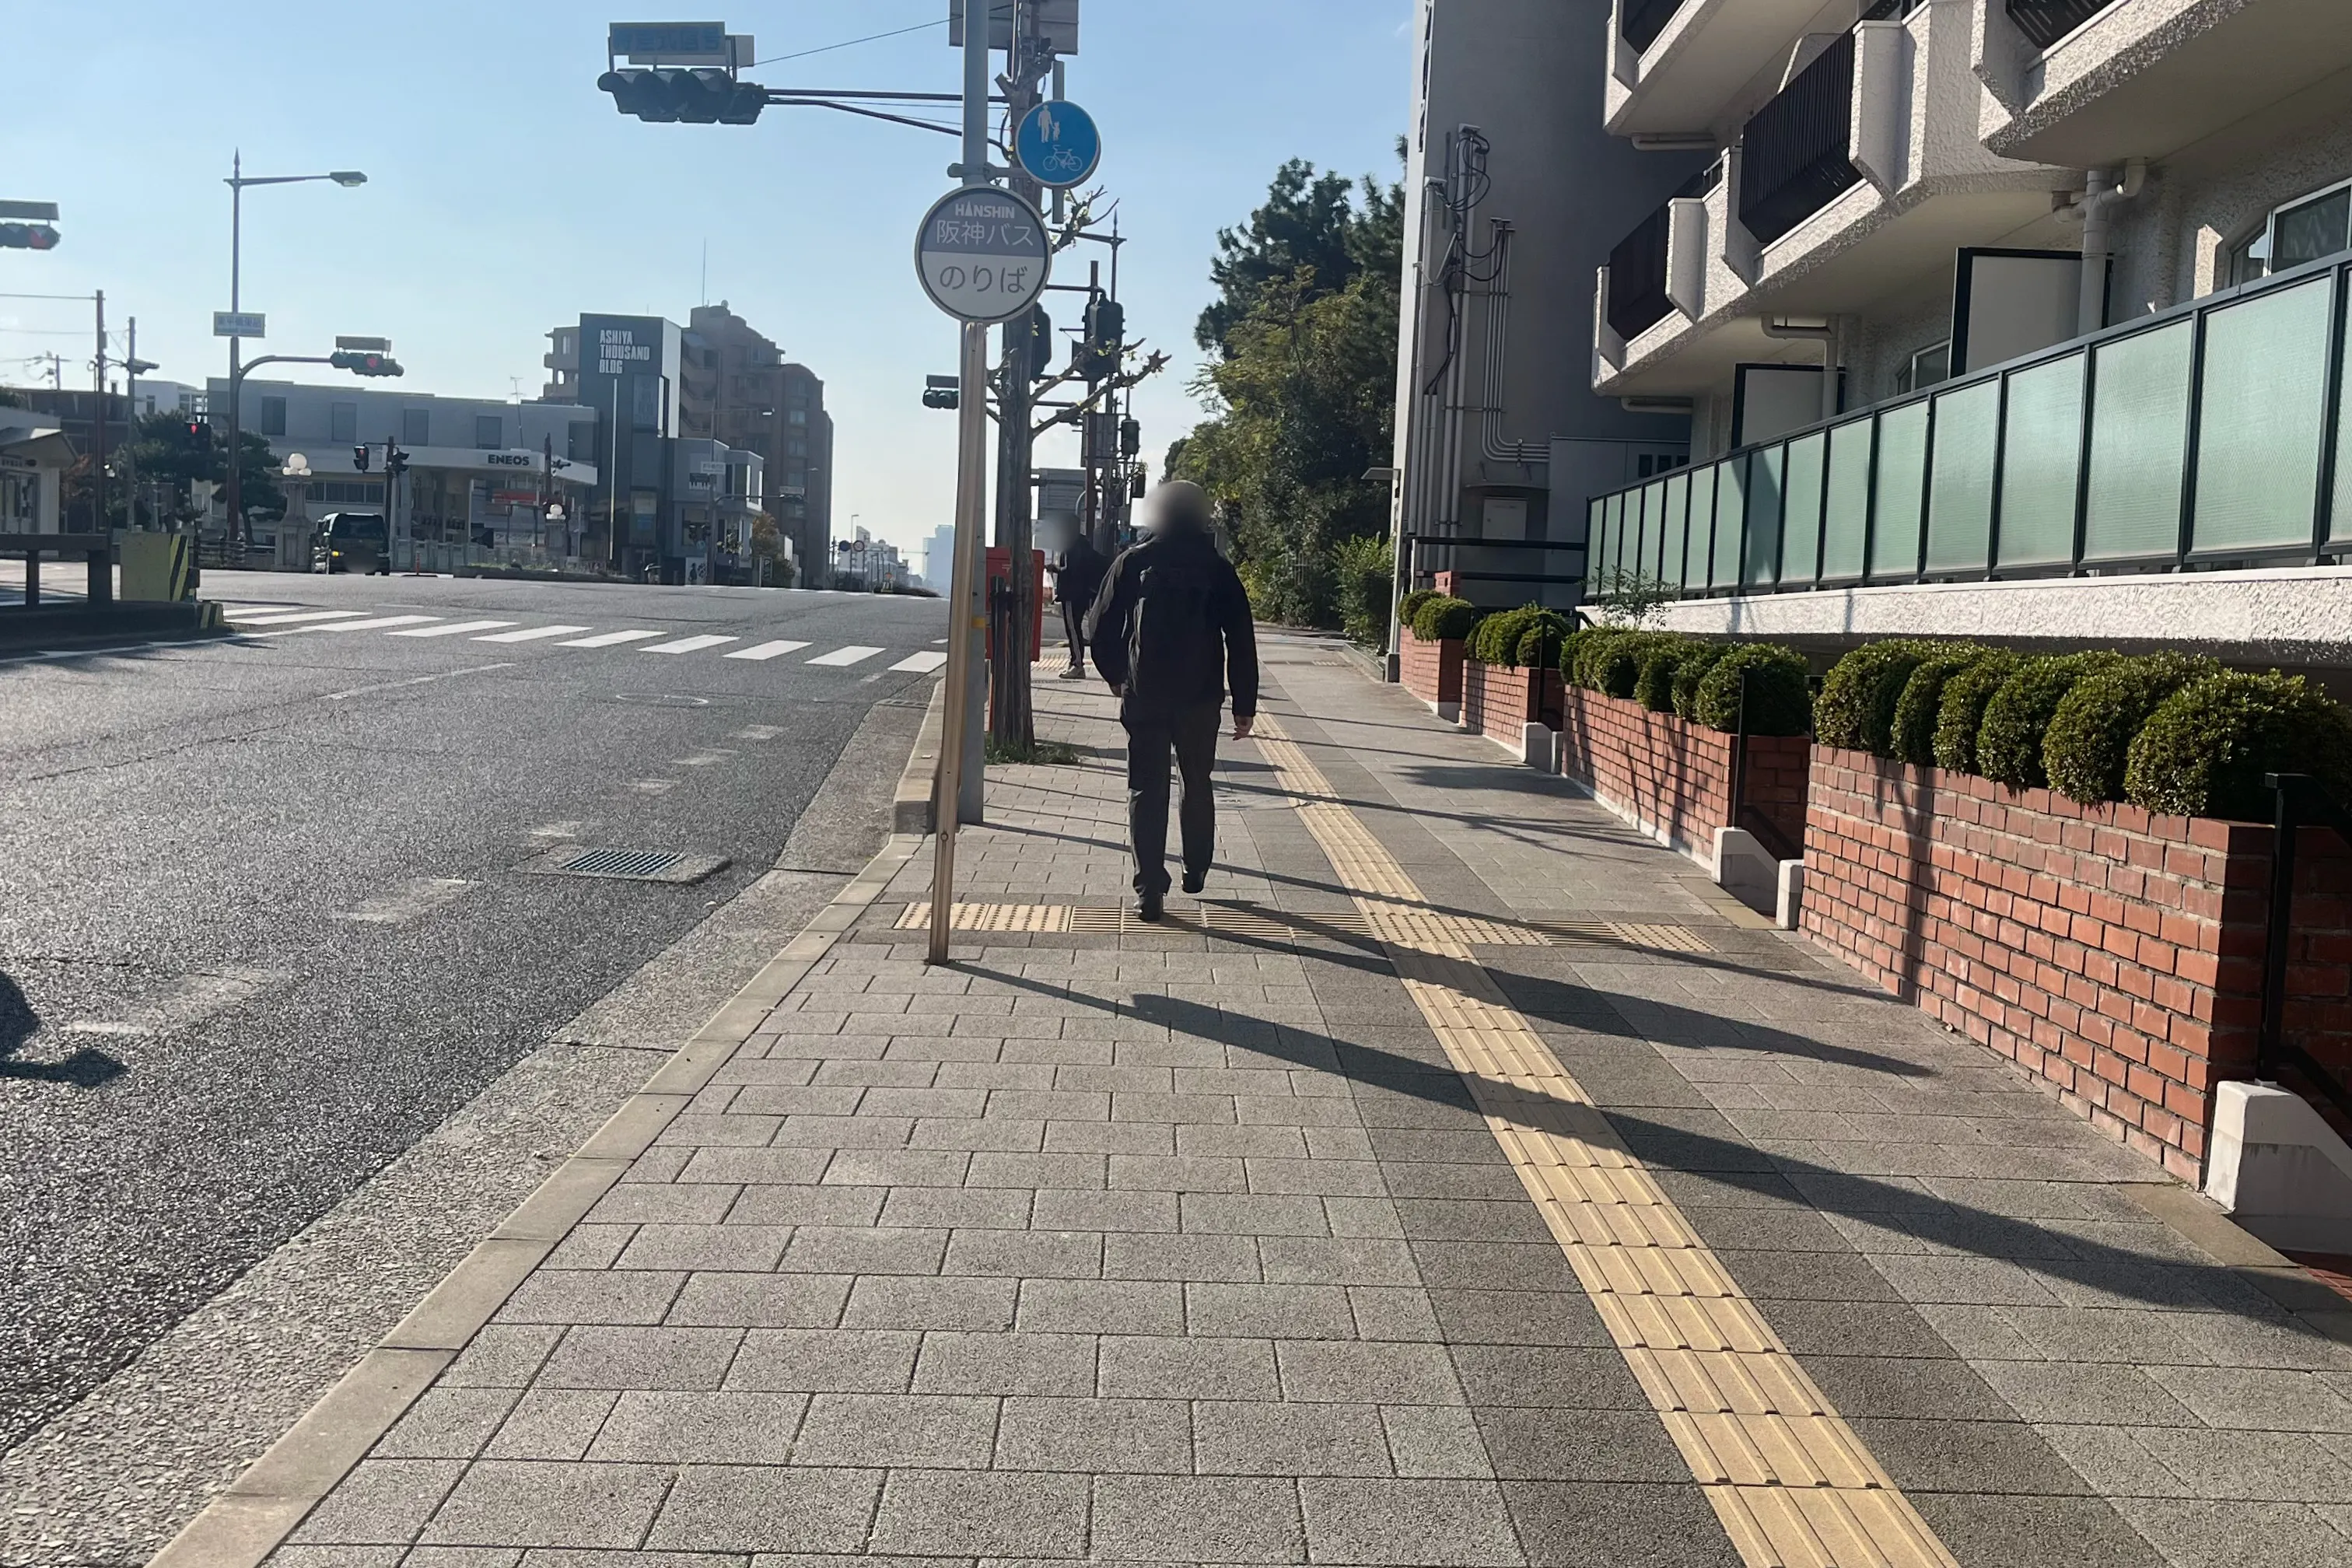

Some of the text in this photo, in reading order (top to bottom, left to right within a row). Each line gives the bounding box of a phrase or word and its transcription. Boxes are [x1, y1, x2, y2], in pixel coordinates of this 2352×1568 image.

[954, 200, 1015, 219] HANSHIN
[936, 219, 1034, 247] 阪神バス
[940, 264, 1028, 293] のりば
[600, 329, 632, 345] ASHIYA
[600, 344, 650, 361] THOUSAND
[488, 454, 530, 466] ENEOS
